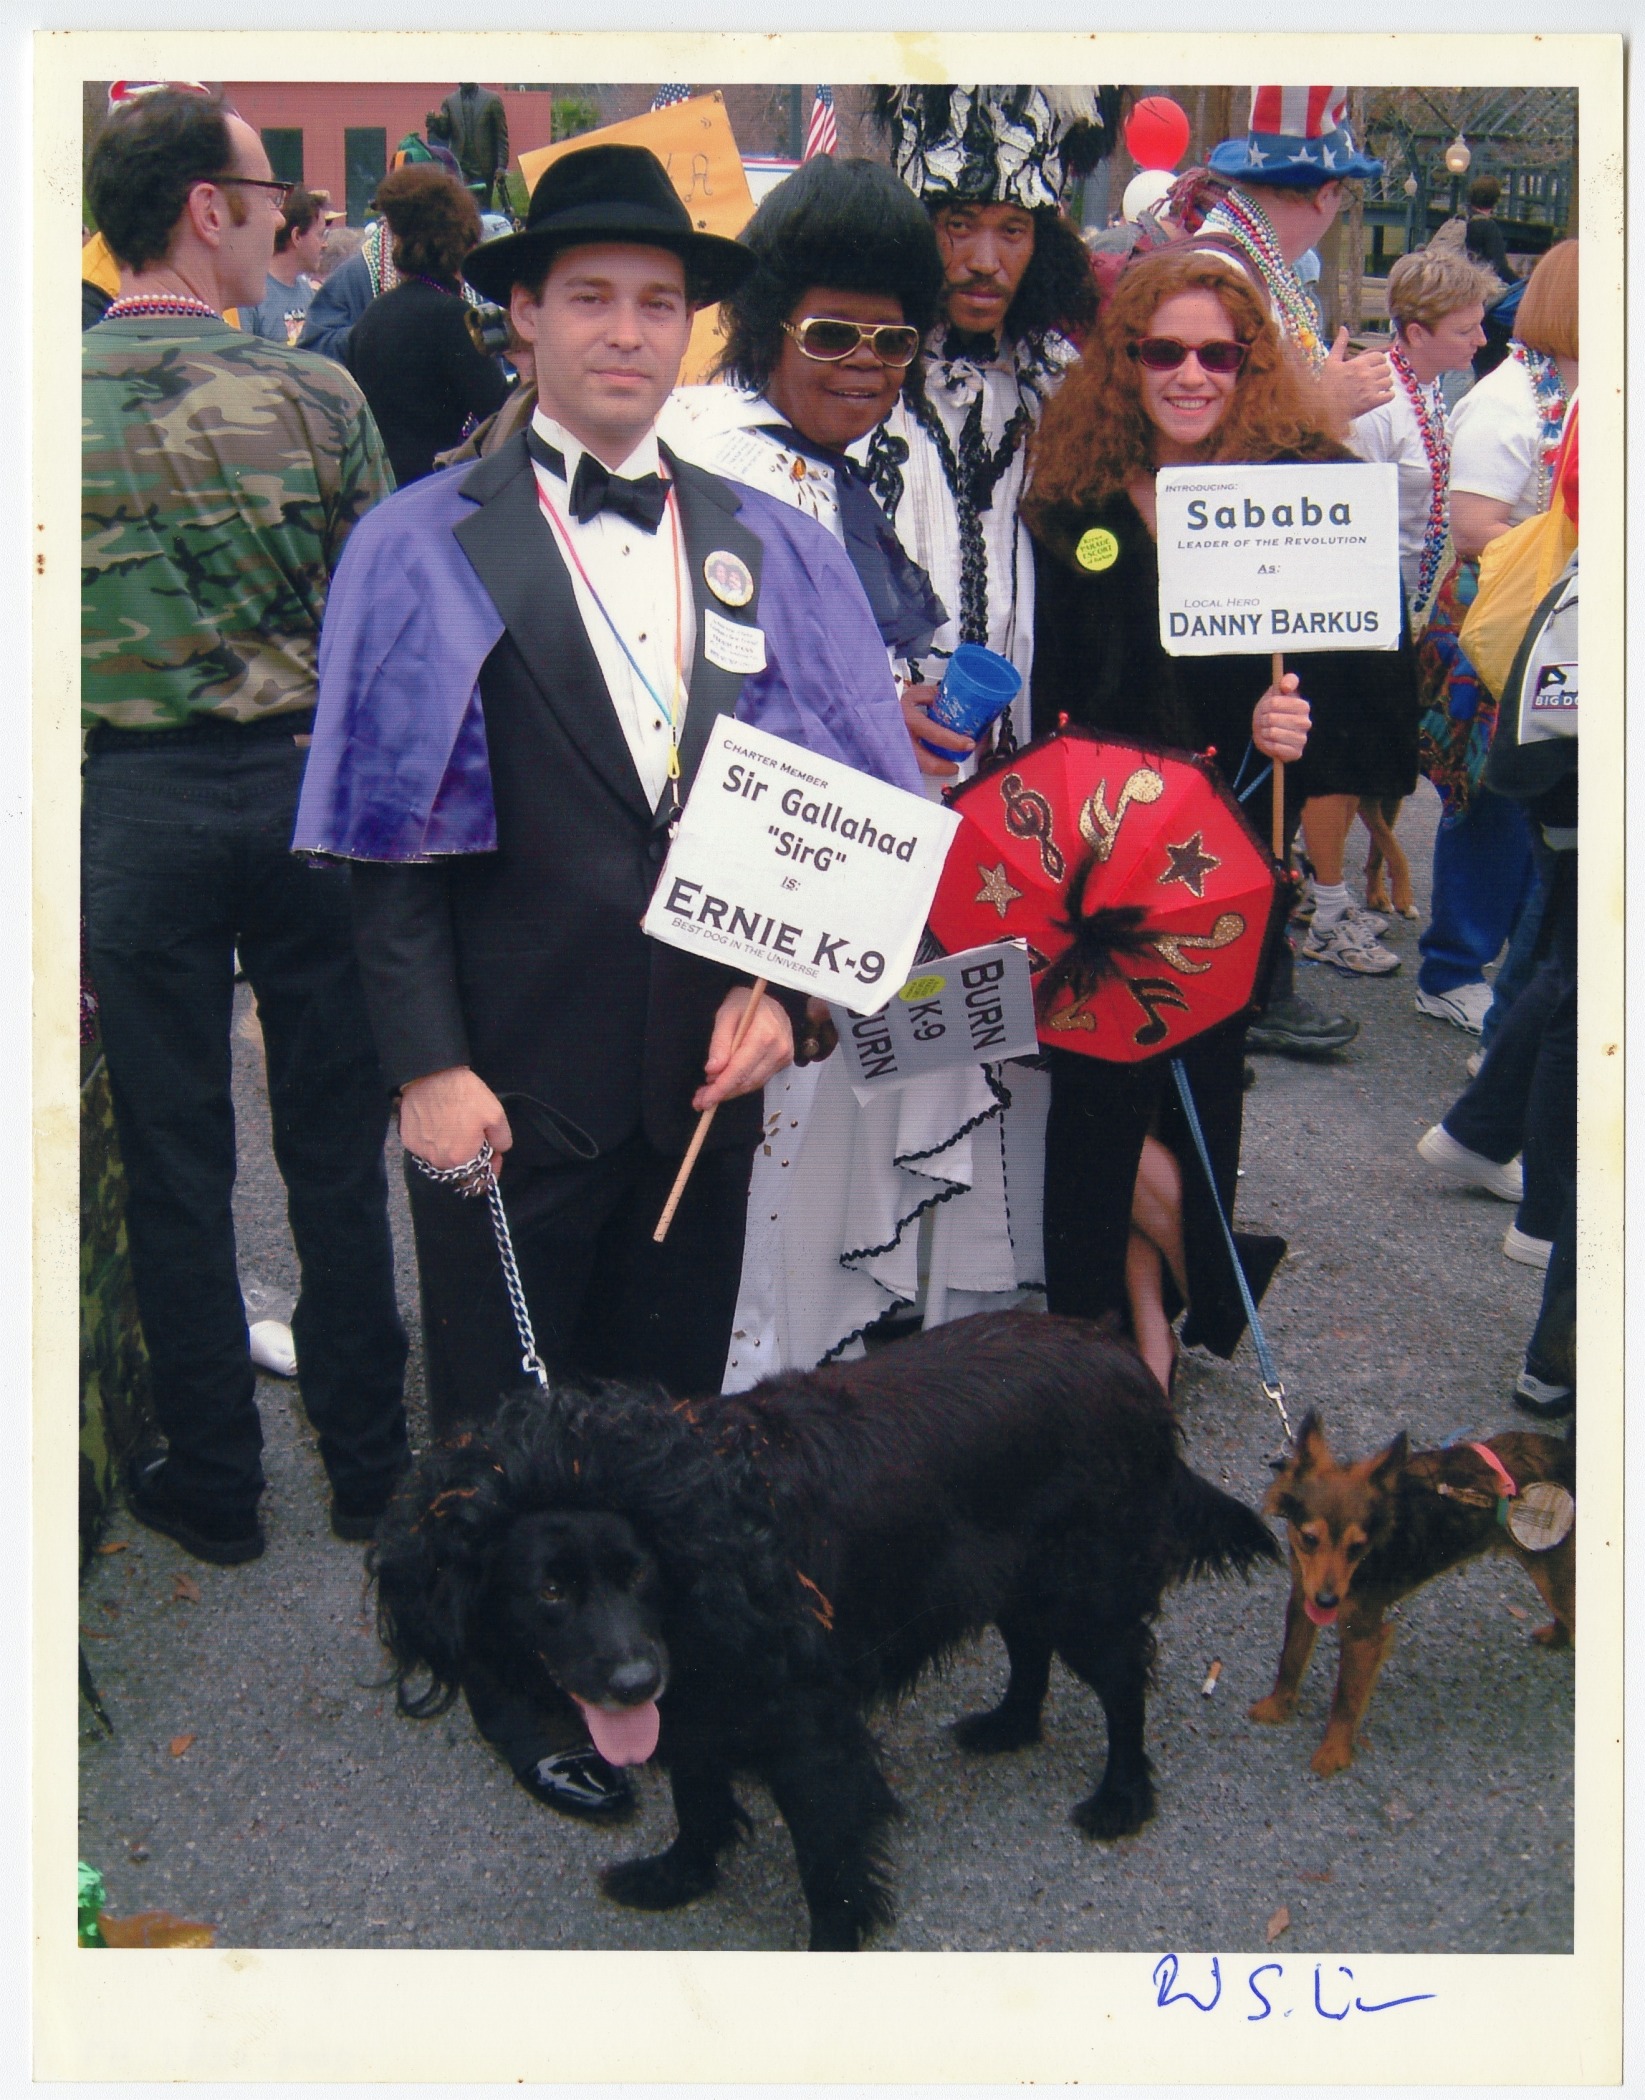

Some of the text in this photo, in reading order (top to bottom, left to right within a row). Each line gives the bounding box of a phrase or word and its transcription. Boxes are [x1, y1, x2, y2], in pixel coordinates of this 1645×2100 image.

[1165, 483, 1239, 493] INTRODUCING:
[1187, 496, 1352, 531] Sababa
[1177, 536, 1368, 549] LEADER OF THE REVOLUTION
[1169, 609, 1380, 637] DANNY BARKUS
[1184, 597, 1260, 608] LOCAL HERO
[1535, 696, 1560, 706] BIG
[723, 739, 829, 790] CHARTER MEMBER
[721, 764, 918, 863] Sir Gallahad
[767, 825, 848, 872] "SirG"
[663, 876, 886, 984] ERNIE K-9
[671, 916, 820, 979] BEST DOG IN THE UNIVERSE
[908, 1000, 946, 1042] K-9
[960, 958, 1006, 1051] BURN
